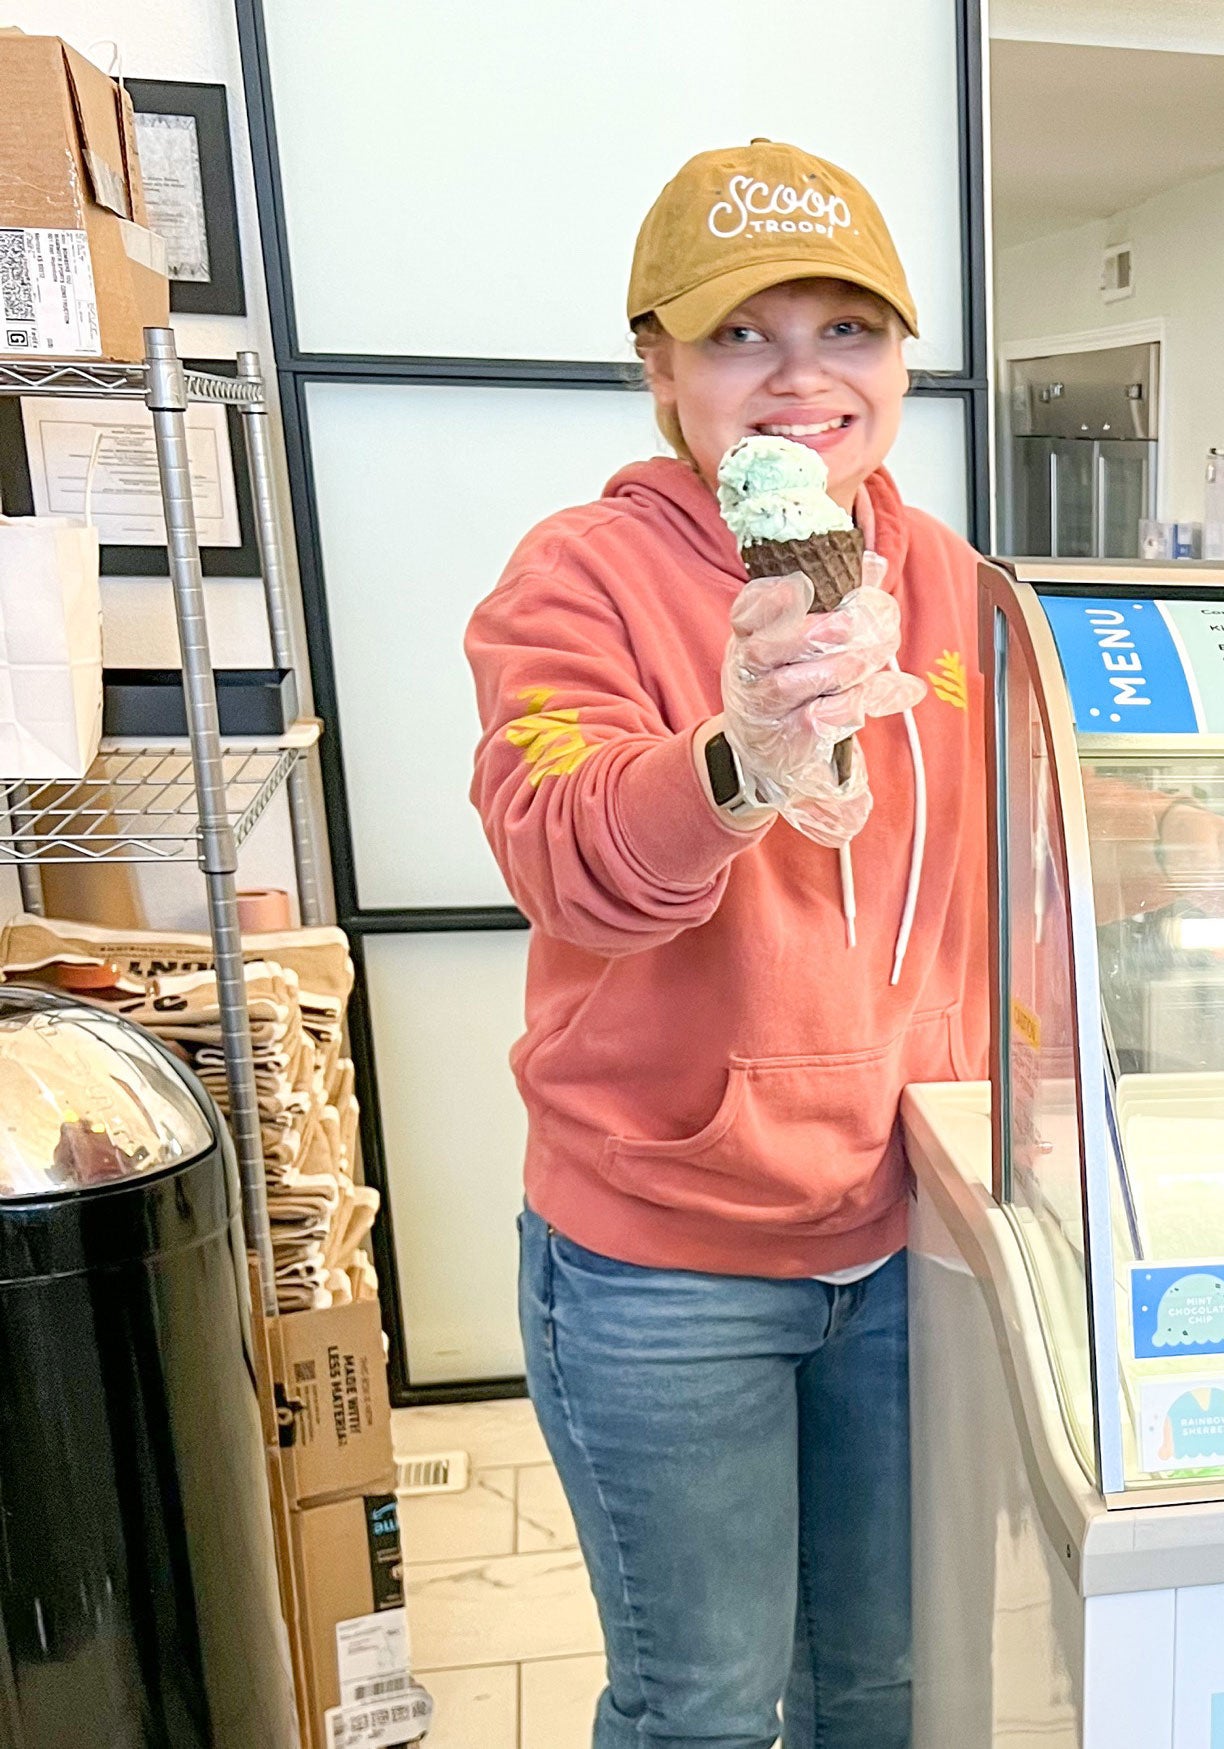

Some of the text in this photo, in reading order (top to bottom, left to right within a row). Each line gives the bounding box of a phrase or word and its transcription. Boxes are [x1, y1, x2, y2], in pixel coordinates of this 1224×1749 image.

[708, 175, 851, 238] Scoop
[10, 332, 26, 344] G
[1085, 608, 1152, 706] MENU
[1186, 1296, 1213, 1306] MINT
[1188, 1315, 1214, 1325] CHIP
[327, 1345, 342, 1378] LESS
[342, 1355, 362, 1434] MADE WITH
